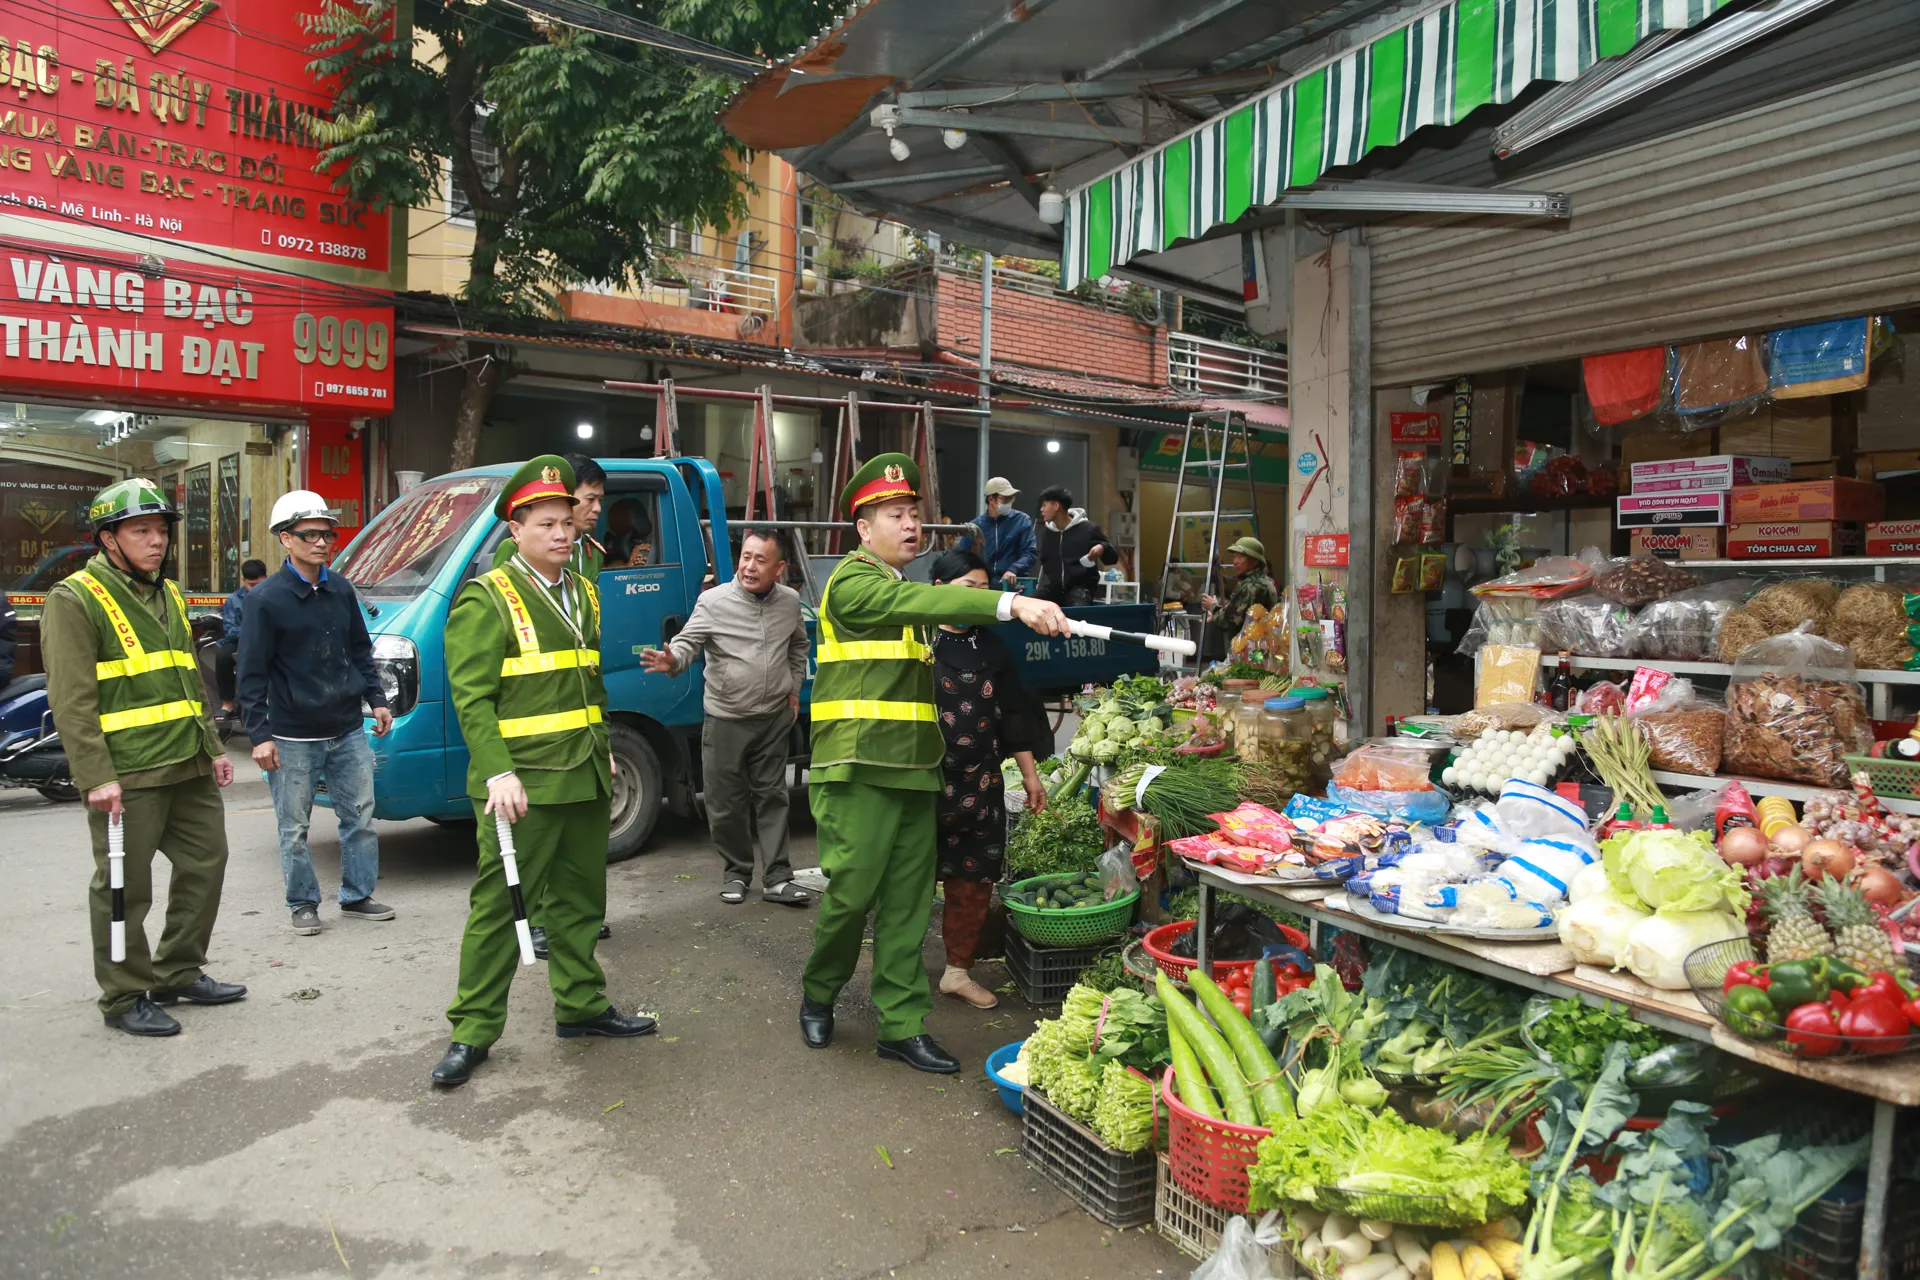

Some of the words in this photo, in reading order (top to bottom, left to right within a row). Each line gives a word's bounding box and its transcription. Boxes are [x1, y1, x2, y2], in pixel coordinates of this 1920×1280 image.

[94, 54, 141, 113] ĐÁ
[45, 150, 124, 188] VÀNG
[140, 170, 195, 199] BẠC
[217, 183, 305, 218] TRANG
[61, 201, 84, 217] Mê
[92, 206, 122, 223] Linh
[135, 213, 153, 228] Hà
[160, 217, 182, 234] Nội
[278, 235, 314, 252] 0972
[318, 241, 367, 260] 138878
[10, 254, 145, 313] VÀNG
[163, 279, 253, 329] BẠC
[0, 314, 163, 372] THÀNH
[181, 335, 265, 385] ĐẠT
[293, 312, 389, 371] 9999
[326, 382, 345, 395] 097
[346, 384, 369, 397] 6658
[371, 387, 388, 398] 701
[321, 445, 350, 480] BẠC
[89, 501, 116, 519] CSTT
[1641, 535, 1693, 549] KOKOMI
[1757, 526, 1800, 536] KOKOMI
[1747, 544, 1767, 553] TÔM
[625, 582, 660, 595] K200
[495, 576, 529, 643] CSTT
[1025, 640, 1051, 661] 29K
[1063, 638, 1106, 658] 158.80
